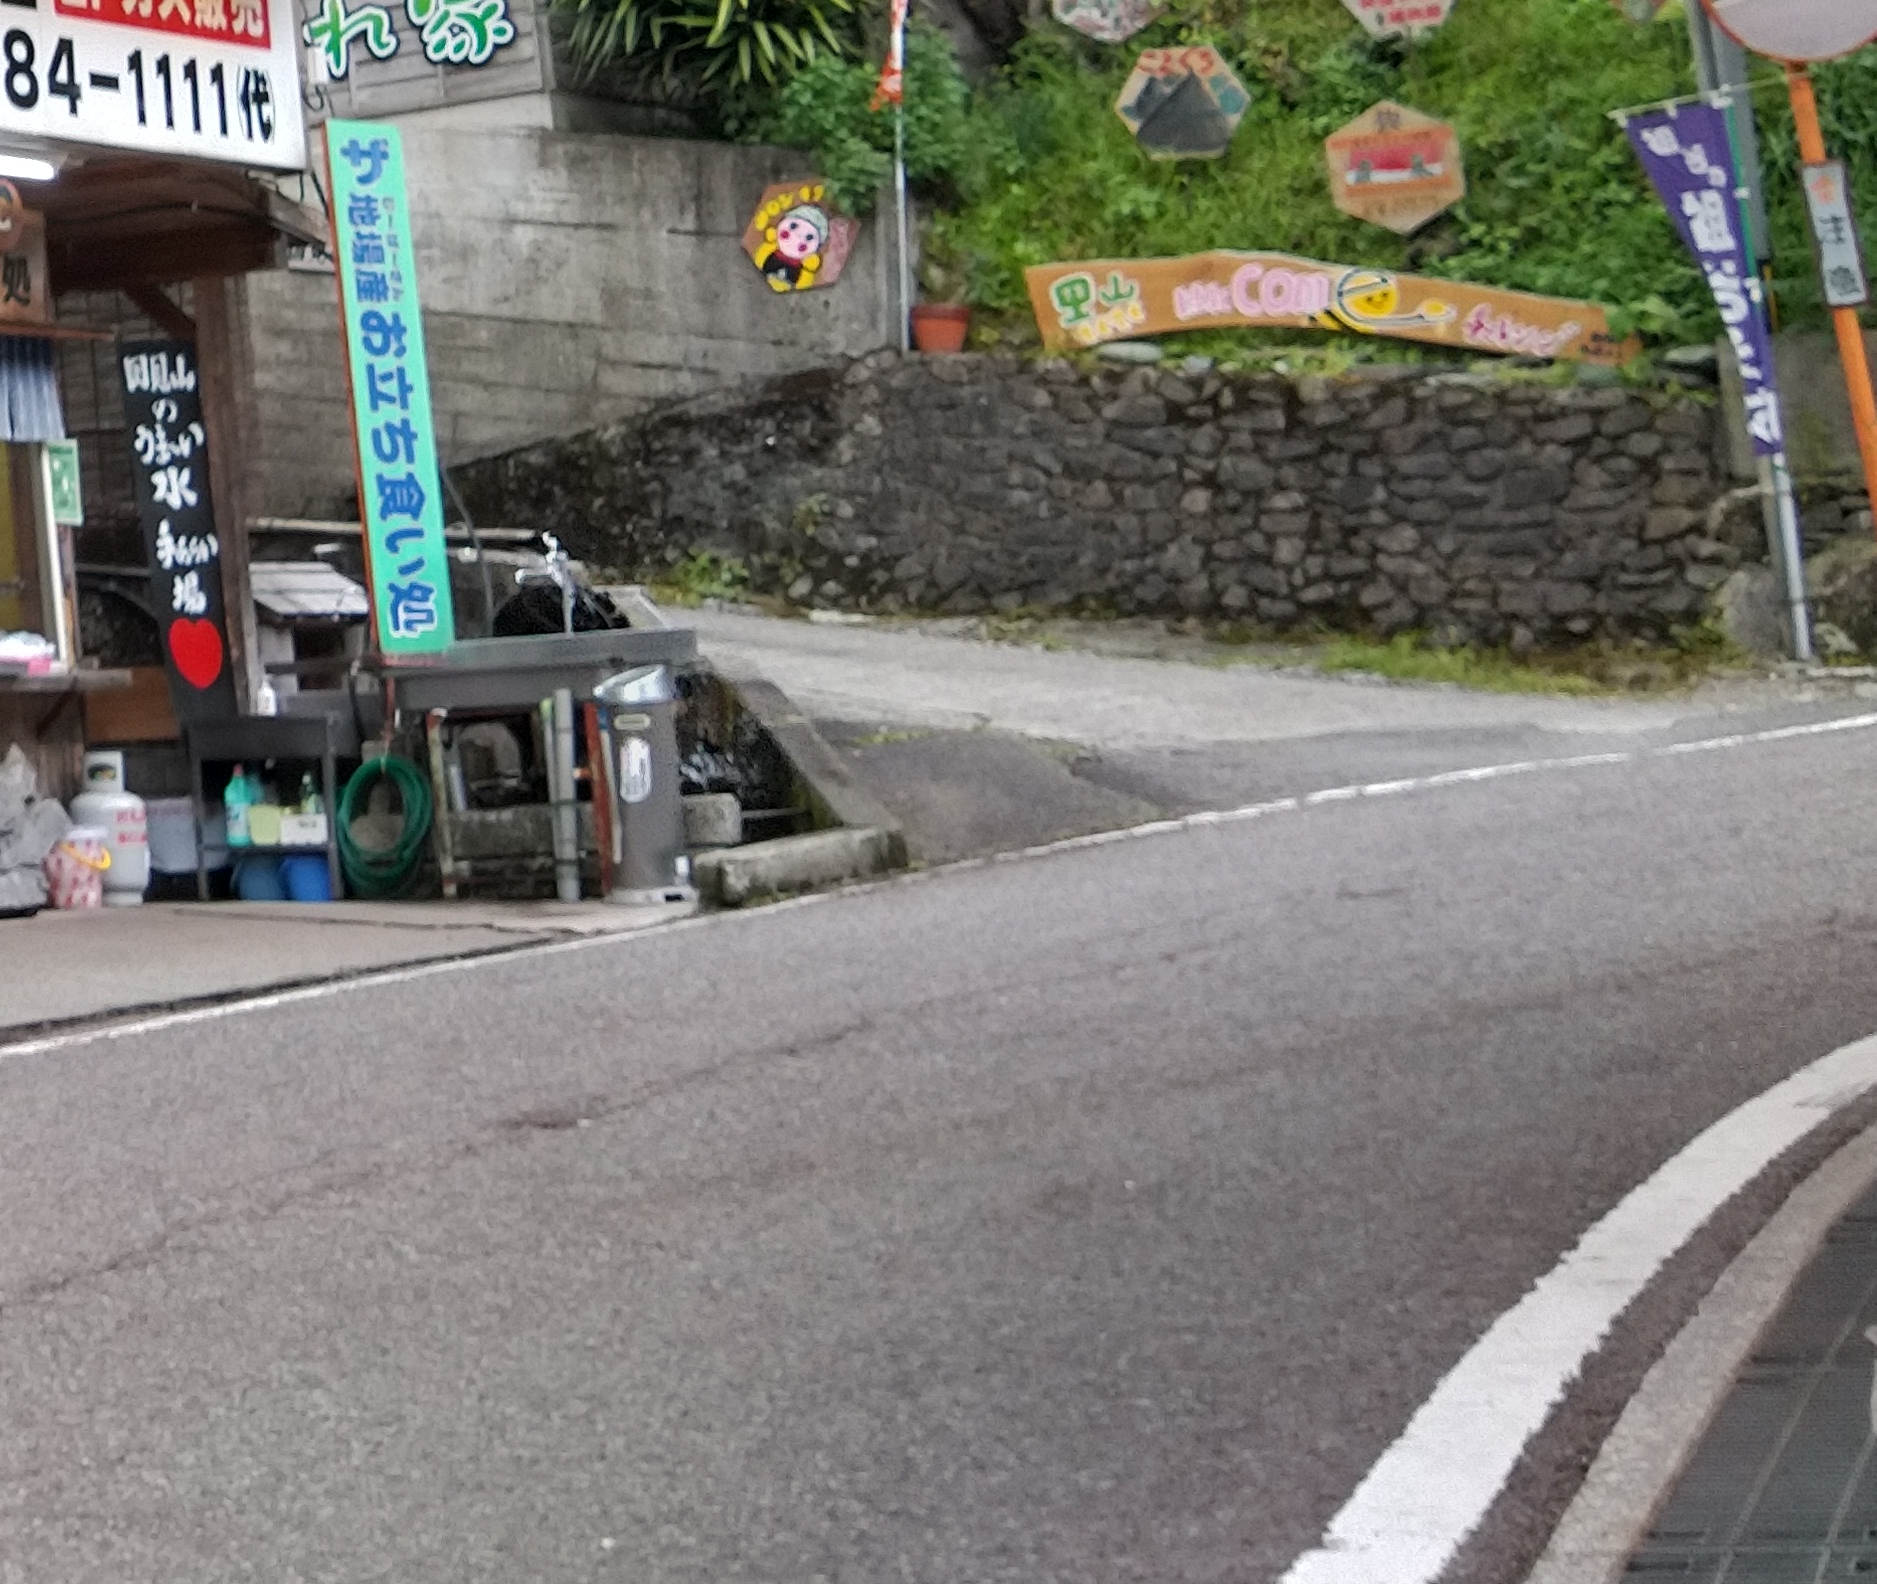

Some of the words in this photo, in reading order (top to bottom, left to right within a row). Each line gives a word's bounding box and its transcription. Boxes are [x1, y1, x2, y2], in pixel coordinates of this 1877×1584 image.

[123, 351, 196, 394] 国見山
[151, 396, 179, 424] の
[150, 466, 199, 510] 水
